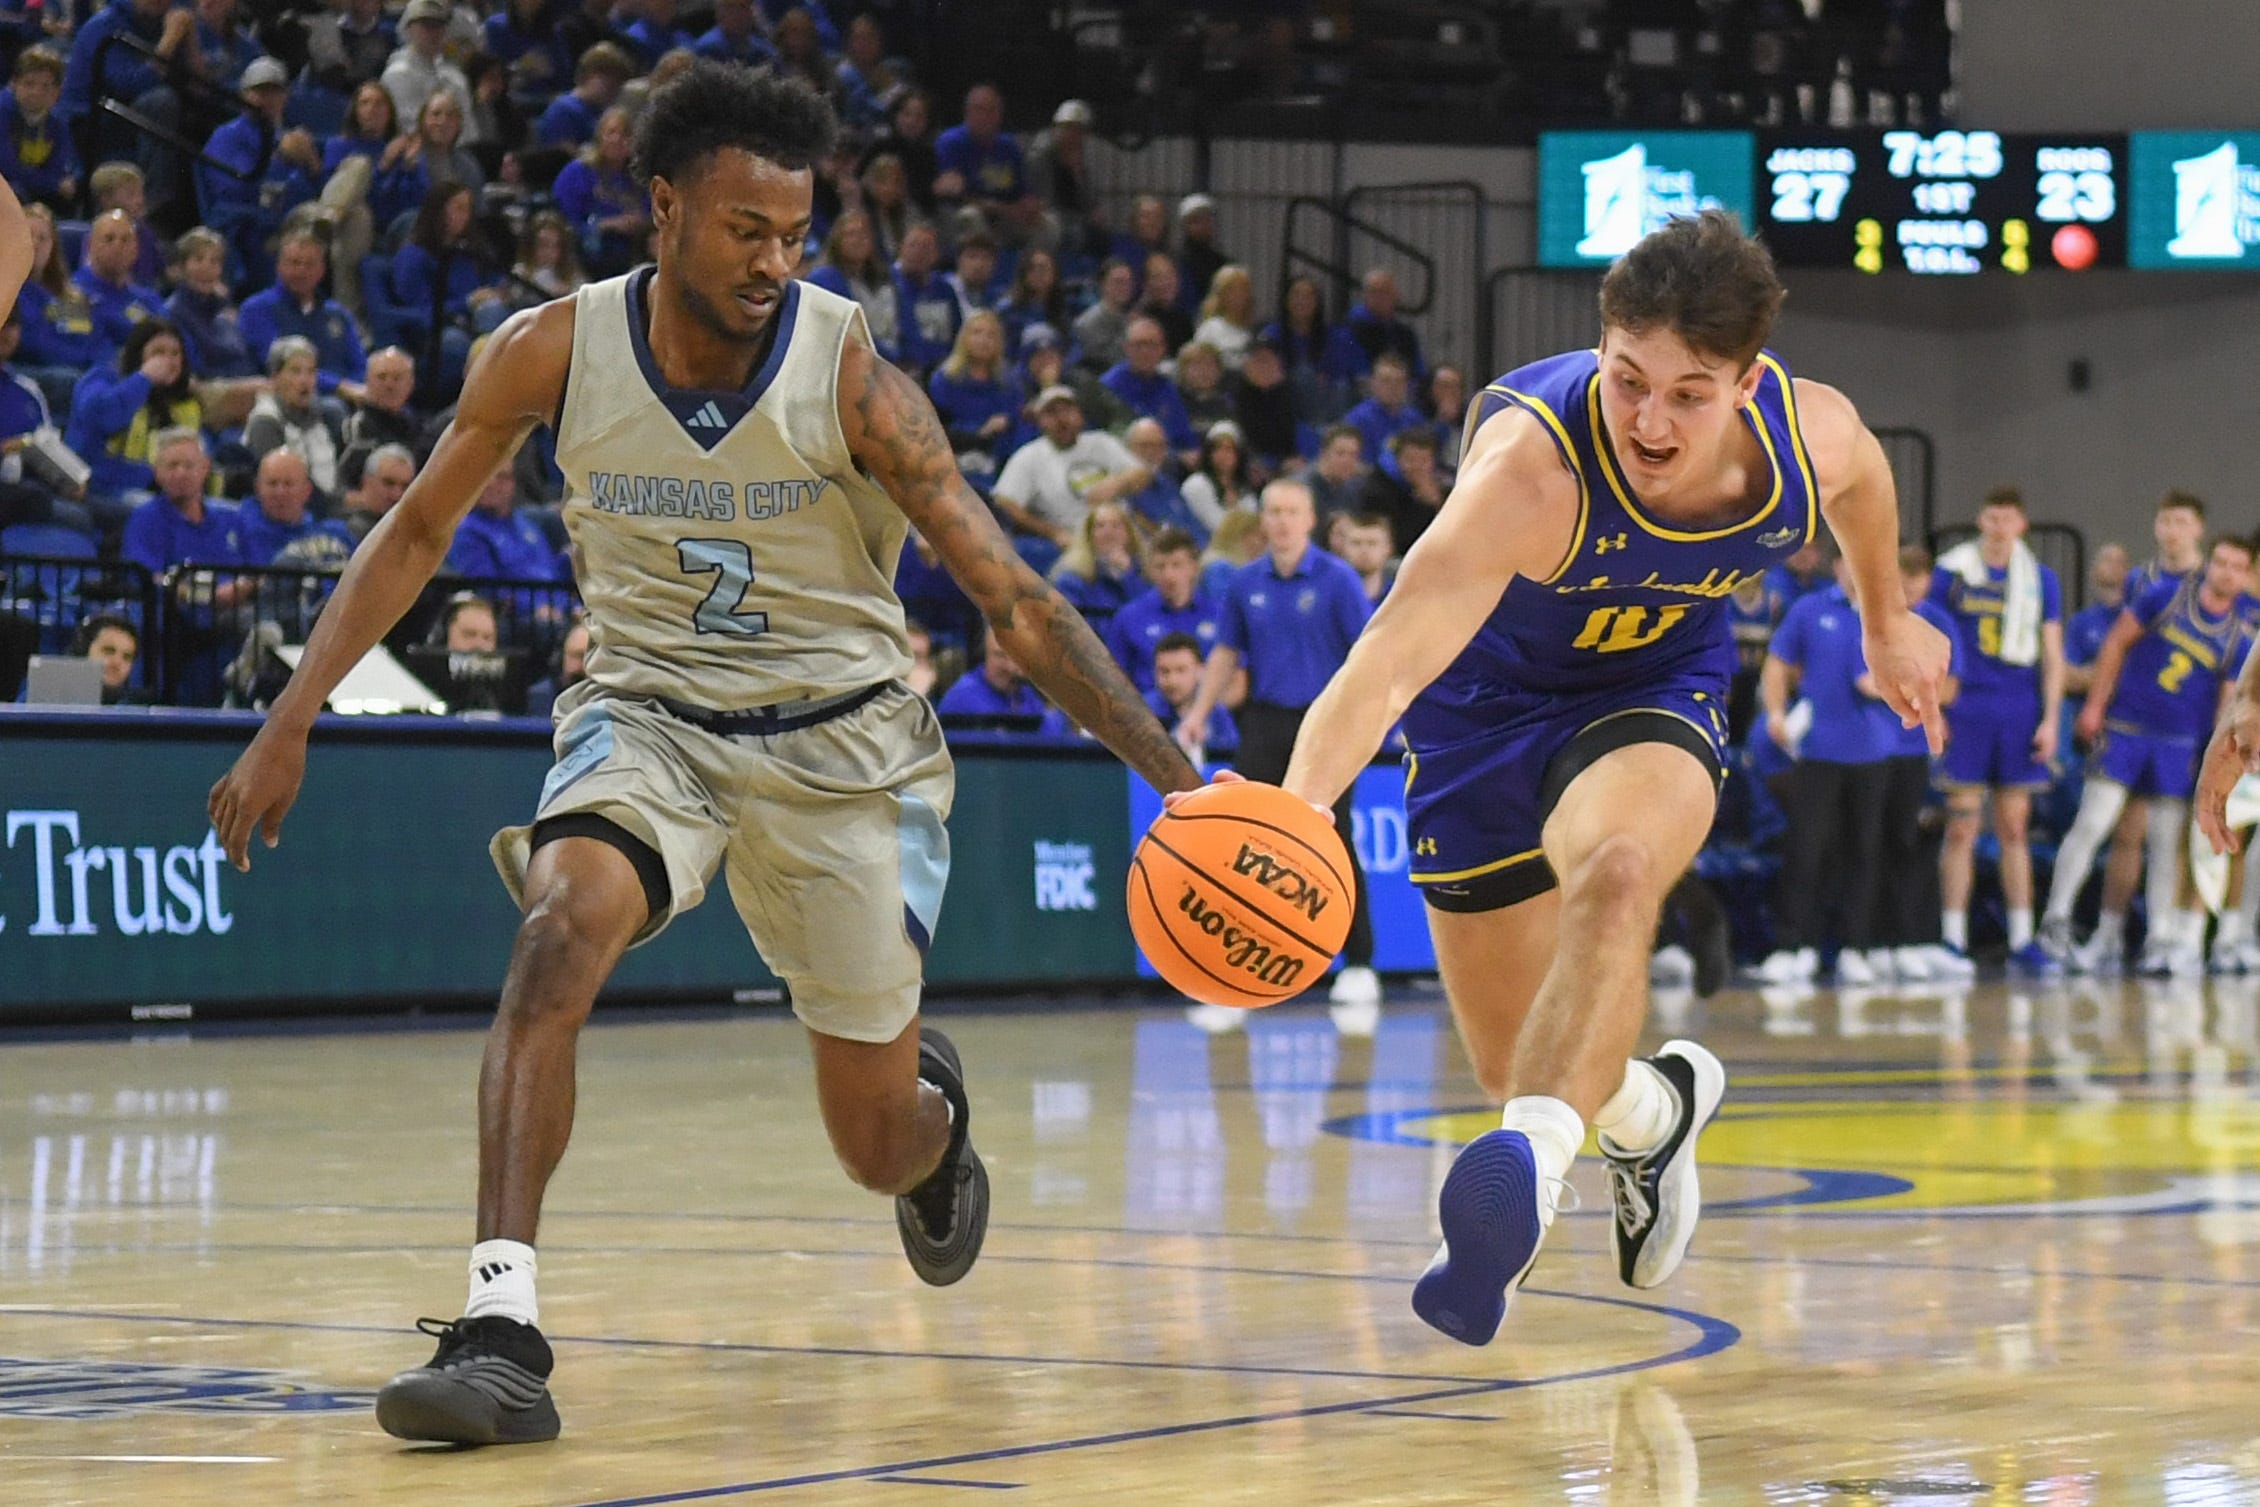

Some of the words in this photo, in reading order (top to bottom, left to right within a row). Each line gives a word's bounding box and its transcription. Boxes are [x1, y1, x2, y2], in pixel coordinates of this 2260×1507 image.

[1882, 130, 2003, 178] 7:25
[1770, 172, 1850, 221] 27
[1912, 182, 1976, 213] 1ST
[2036, 171, 2116, 222] 23
[589, 471, 736, 521] KANSAS
[745, 477, 829, 520] CITY
[673, 537, 770, 635] 2
[2157, 651, 2192, 693] 2
[7, 810, 233, 936] Trust
[1034, 864, 1097, 911] FDIC
[1232, 842, 1329, 922] NCAA
[1178, 884, 1304, 987] Wilson
